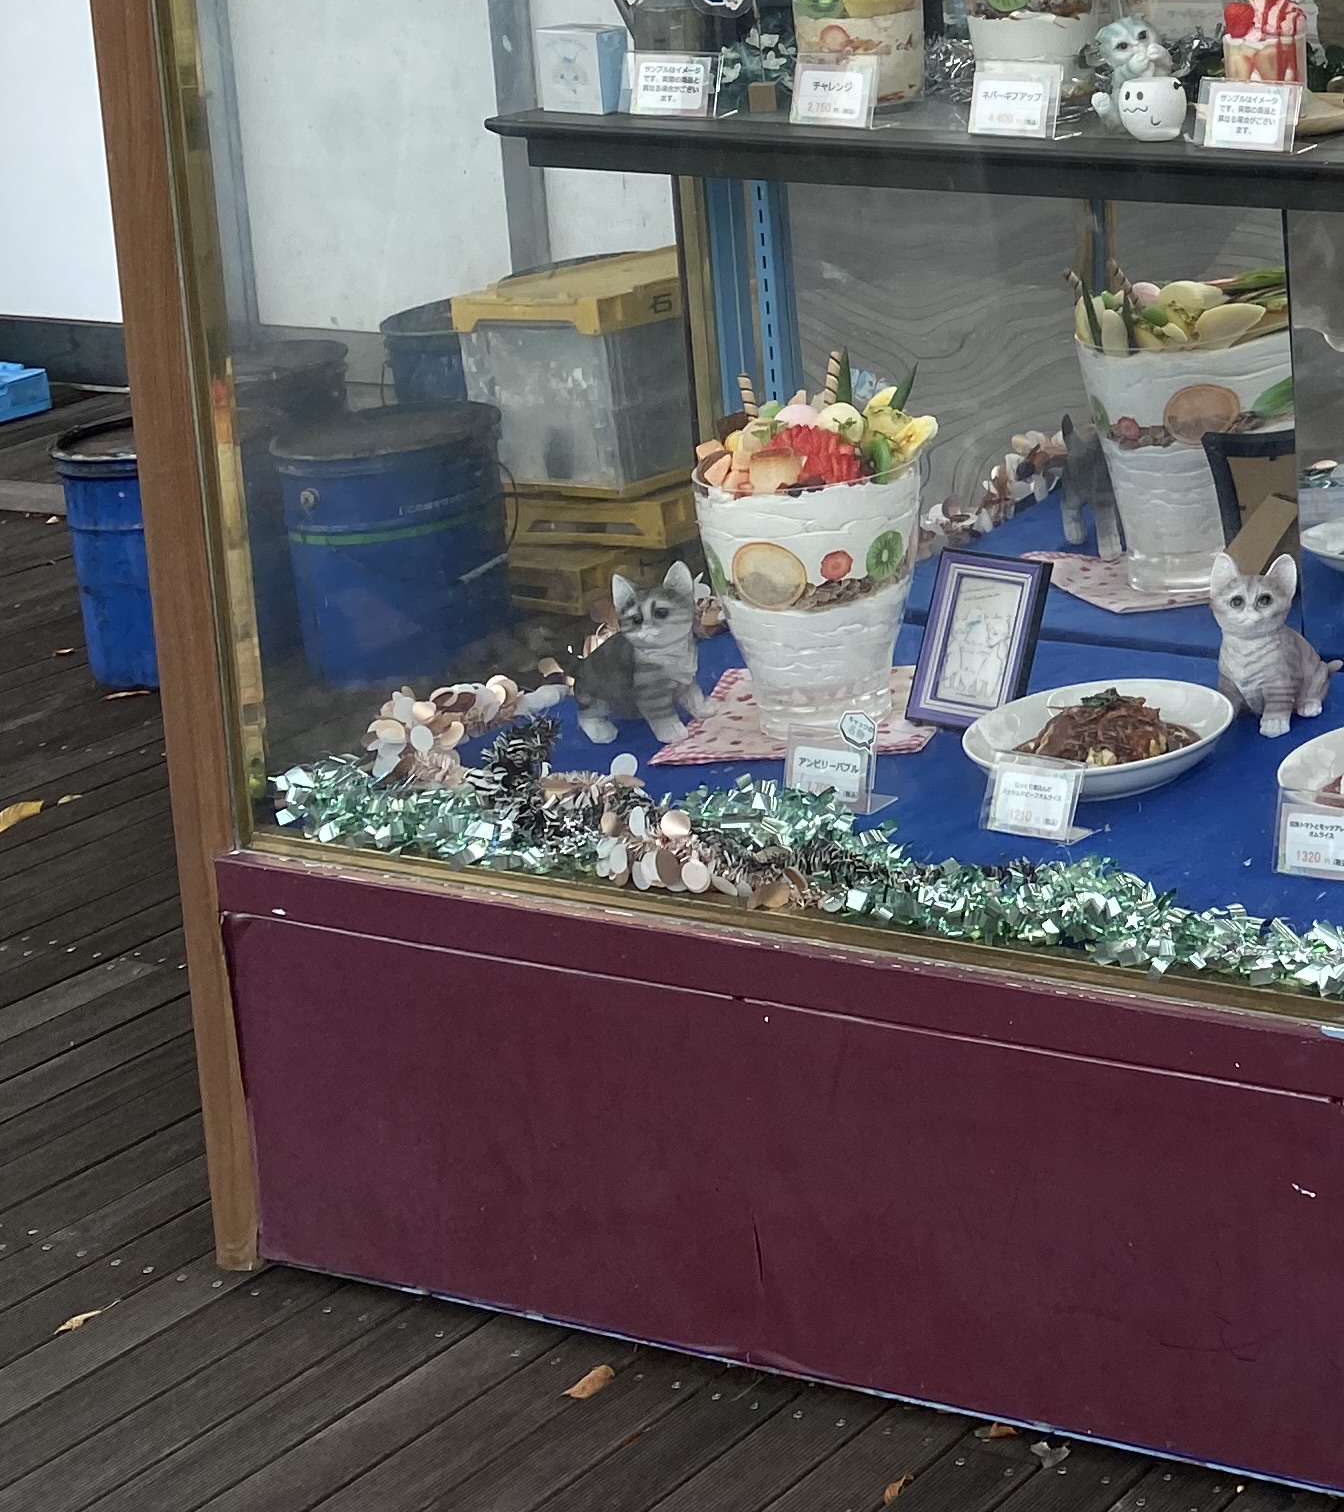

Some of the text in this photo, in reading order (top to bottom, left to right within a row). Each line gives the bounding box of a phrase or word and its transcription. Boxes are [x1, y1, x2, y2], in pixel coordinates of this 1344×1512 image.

[812, 81, 853, 92] チャレンジ
[1296, 850, 1321, 863] 1320
